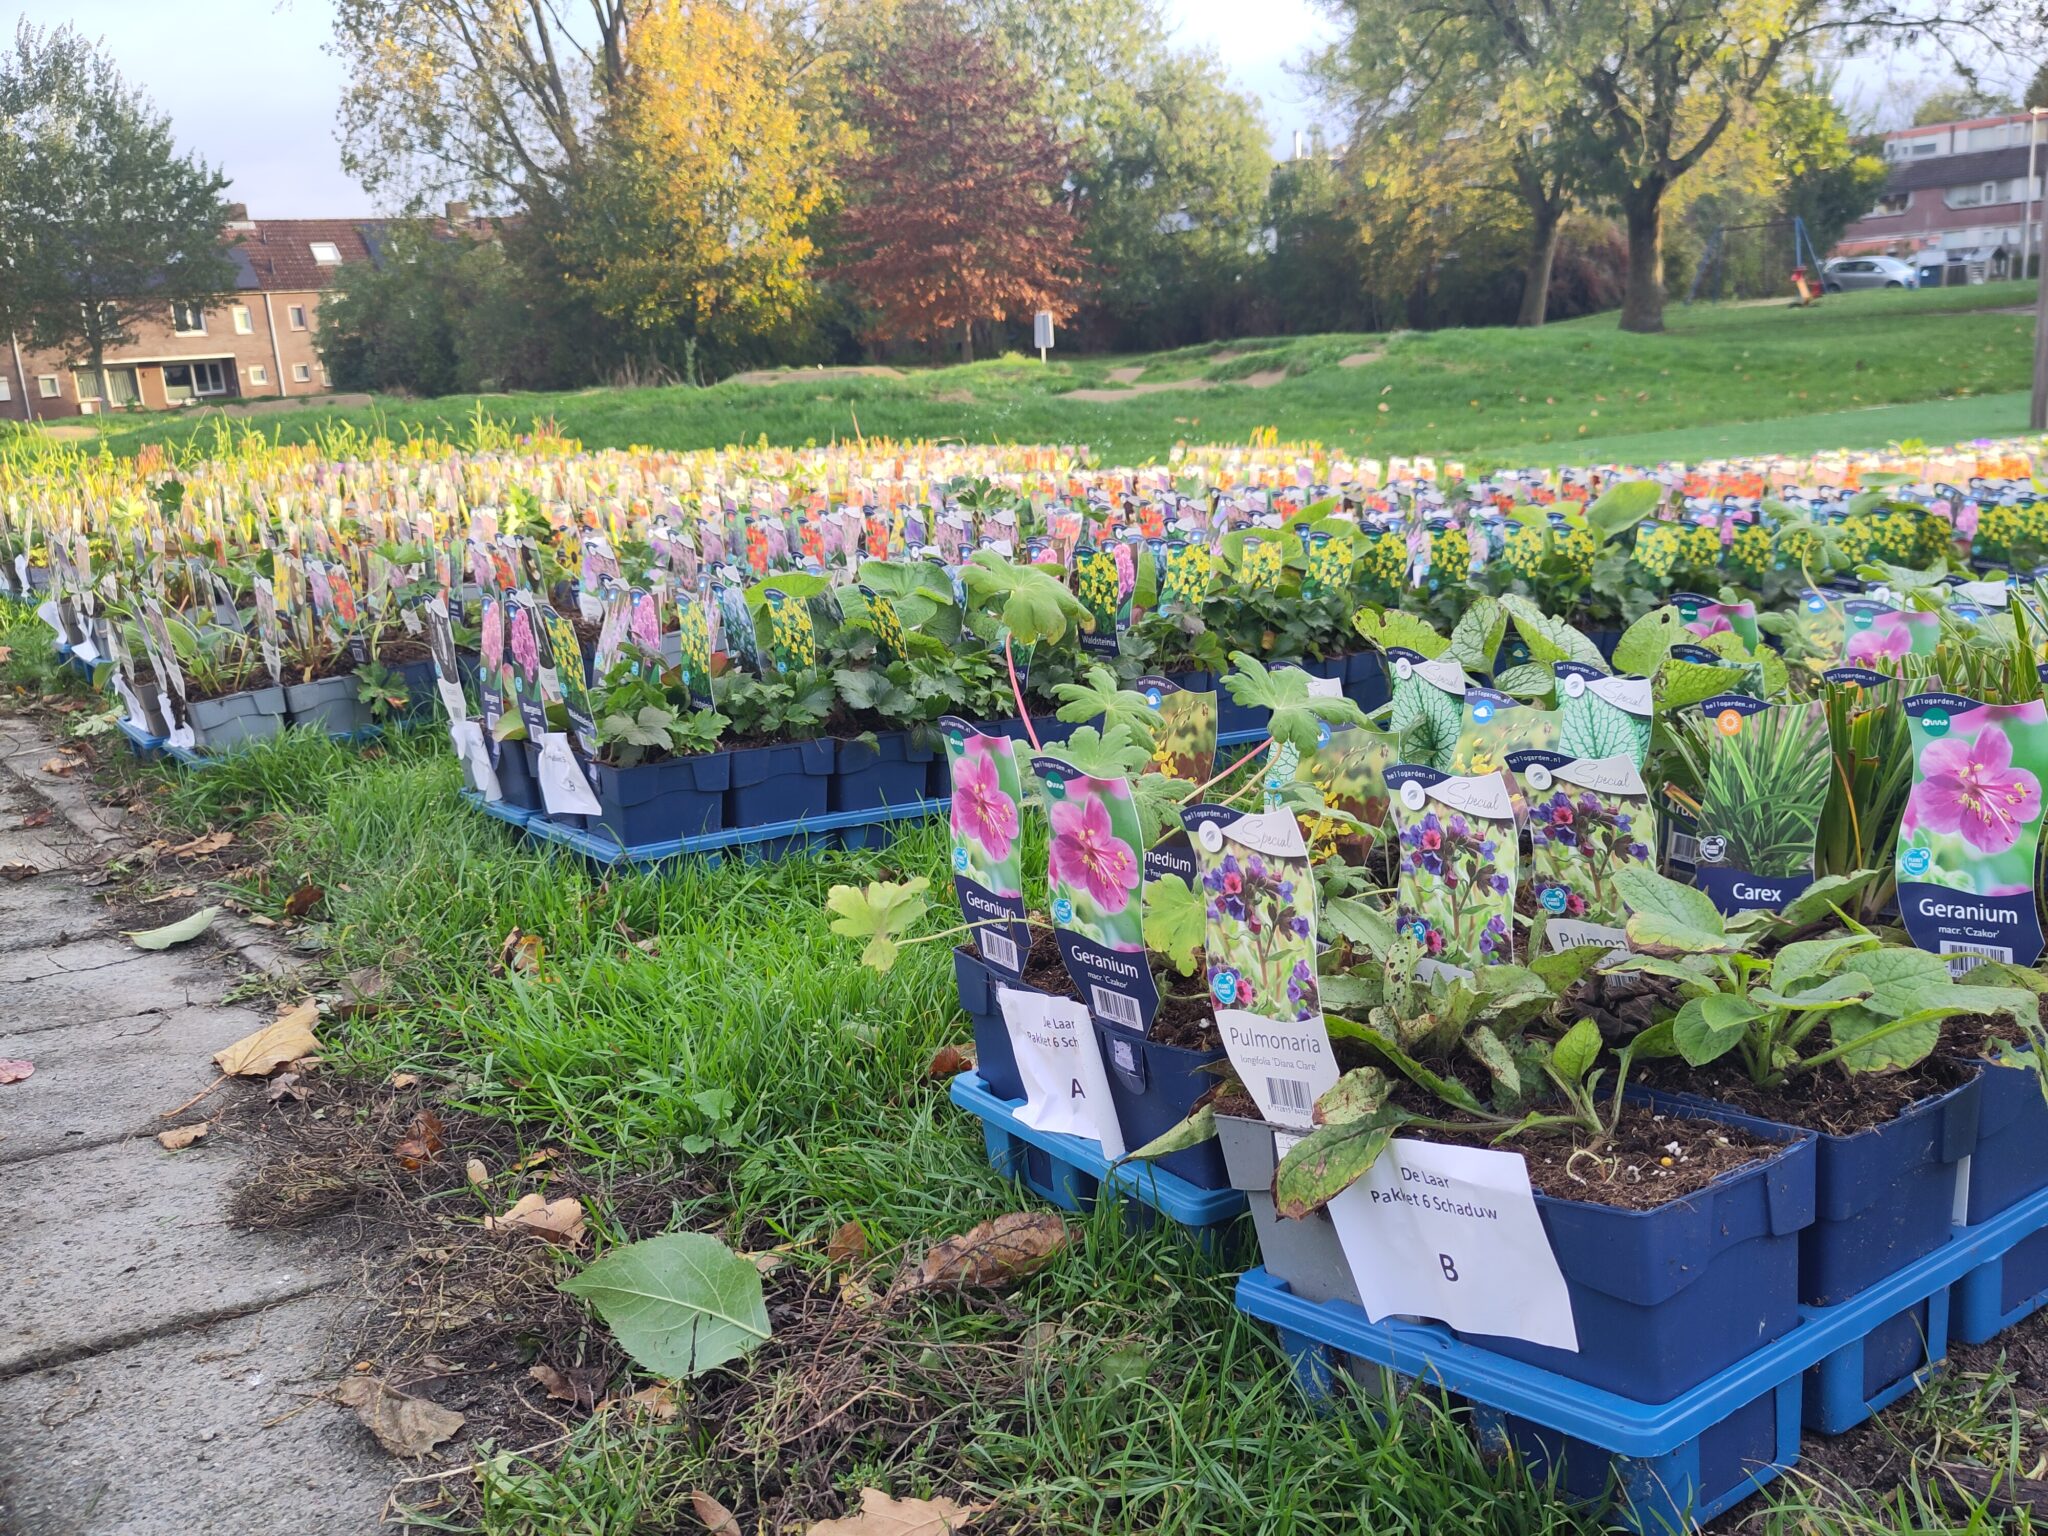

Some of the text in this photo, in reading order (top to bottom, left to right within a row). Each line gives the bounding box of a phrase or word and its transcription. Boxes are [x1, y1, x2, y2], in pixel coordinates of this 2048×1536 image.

[1081, 635, 1117, 648] Waldsteinia
[1556, 664, 1598, 678] hellogarden.nl
[1467, 690, 1511, 705] hellogarden.nl
[1706, 701, 1757, 710] hellogarden.nl
[1907, 698, 1967, 709] hellogarden.nl
[1034, 761, 1074, 776] hellogarden.nl
[1508, 755, 1562, 765] hellogarden.nl
[1386, 771, 1436, 781] hellogarden.nl
[1574, 762, 1630, 788] Special
[1447, 781, 1500, 811] Special
[1184, 810, 1231, 823] hellogarden.nl
[1242, 819, 1292, 849] Special
[1732, 883, 1782, 902] Carex
[966, 890, 1016, 920] Geranium
[1919, 898, 2018, 925] Geranium
[1938, 926, 1962, 935] macr.
[1071, 945, 1139, 980] Geranium
[1052, 1018, 1075, 1030] Laar
[1053, 1036, 1060, 1048] 6
[1229, 1026, 1321, 1054] Pulmonaria
[1071, 1078, 1086, 1099] A
[1400, 1166, 1450, 1189] De Laar
[1370, 1187, 1498, 1220] Pakket 6 Schaduw
[1439, 1253, 1459, 1282] B
